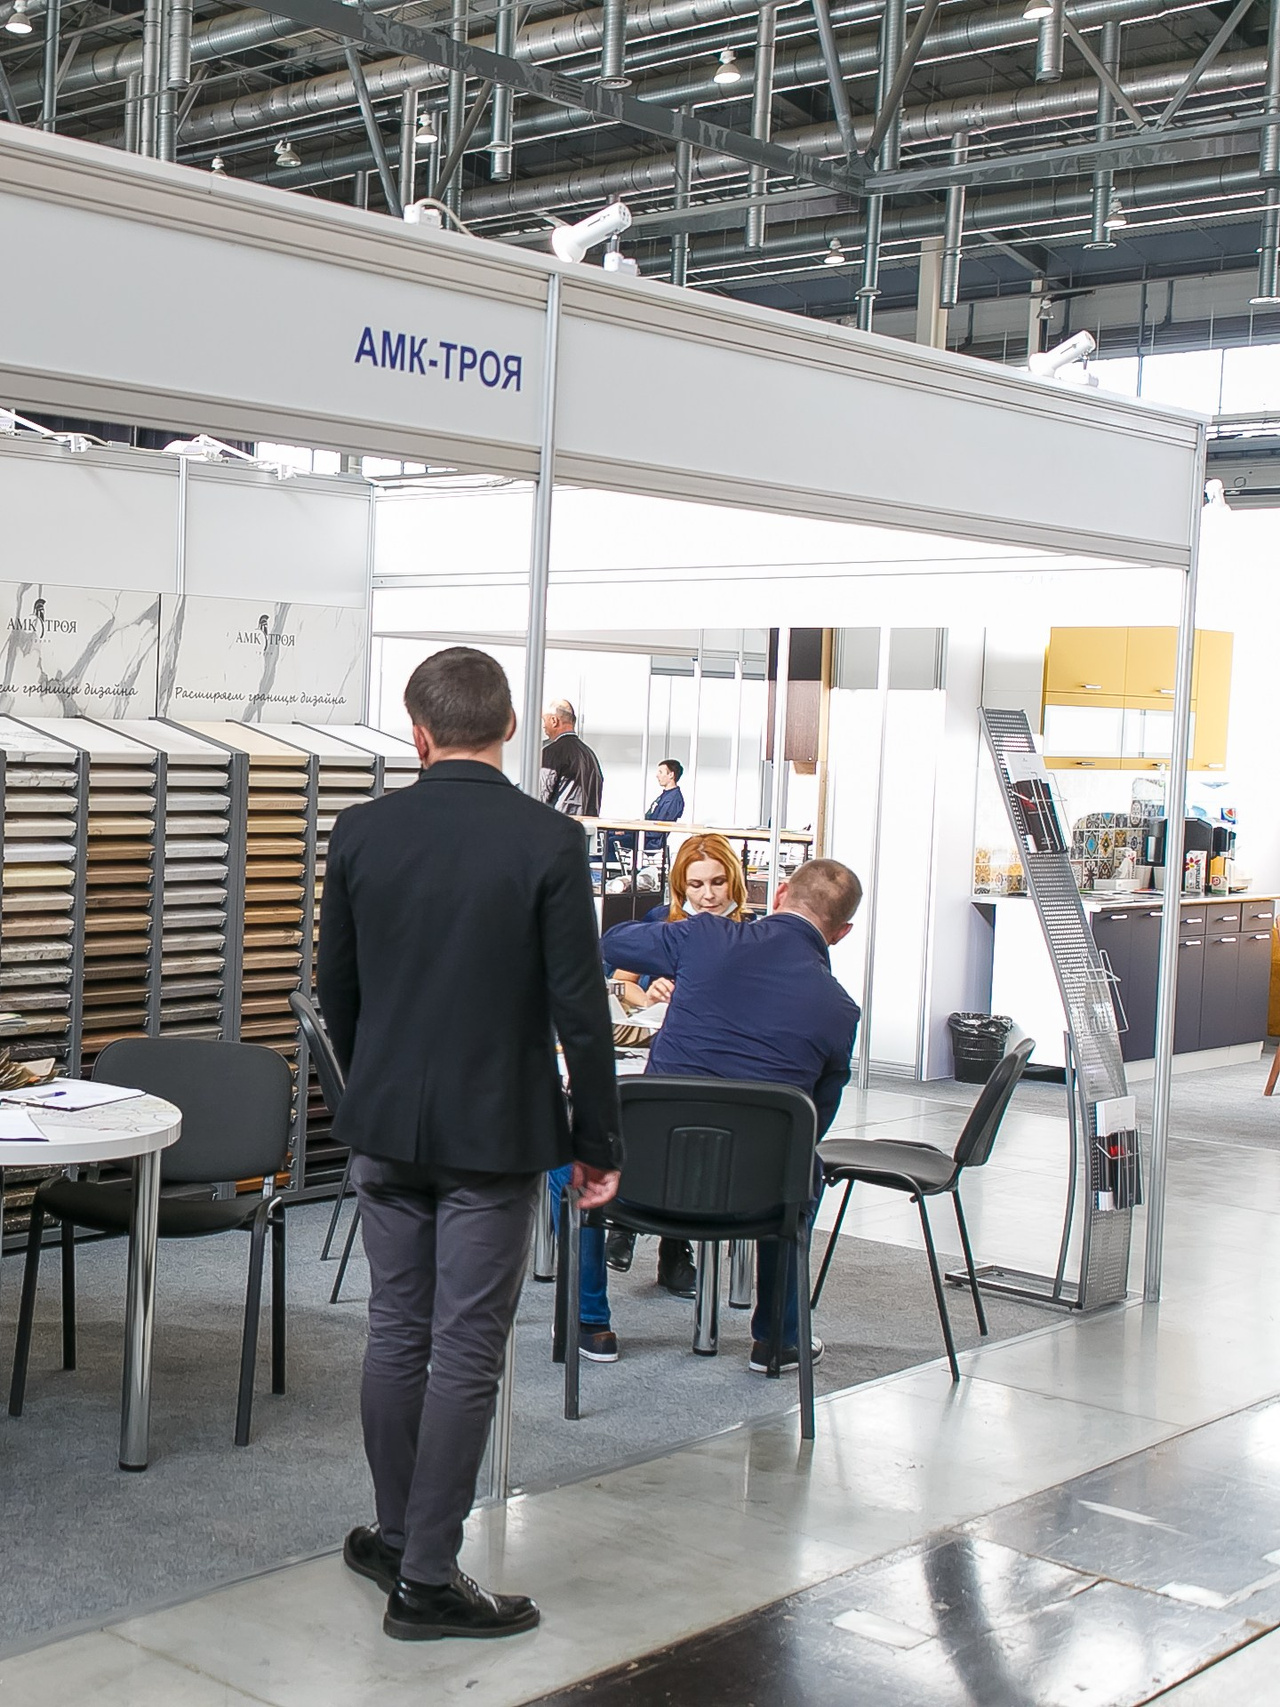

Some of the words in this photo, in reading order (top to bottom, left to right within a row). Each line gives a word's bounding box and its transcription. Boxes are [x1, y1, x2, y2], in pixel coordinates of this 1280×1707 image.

[354, 326, 522, 392] АМК-ТРОЯ
[7, 617, 37, 632] АМК
[45, 619, 77, 633] ТРОЯ
[235, 631, 261, 645] АМК
[269, 633, 296, 647] ТРОЯ
[23, 684, 82, 698] границы
[84, 682, 138, 699] дизайна
[175, 686, 245, 704] Расширяем
[248, 692, 299, 707] границы
[300, 691, 347, 707] дизайна
